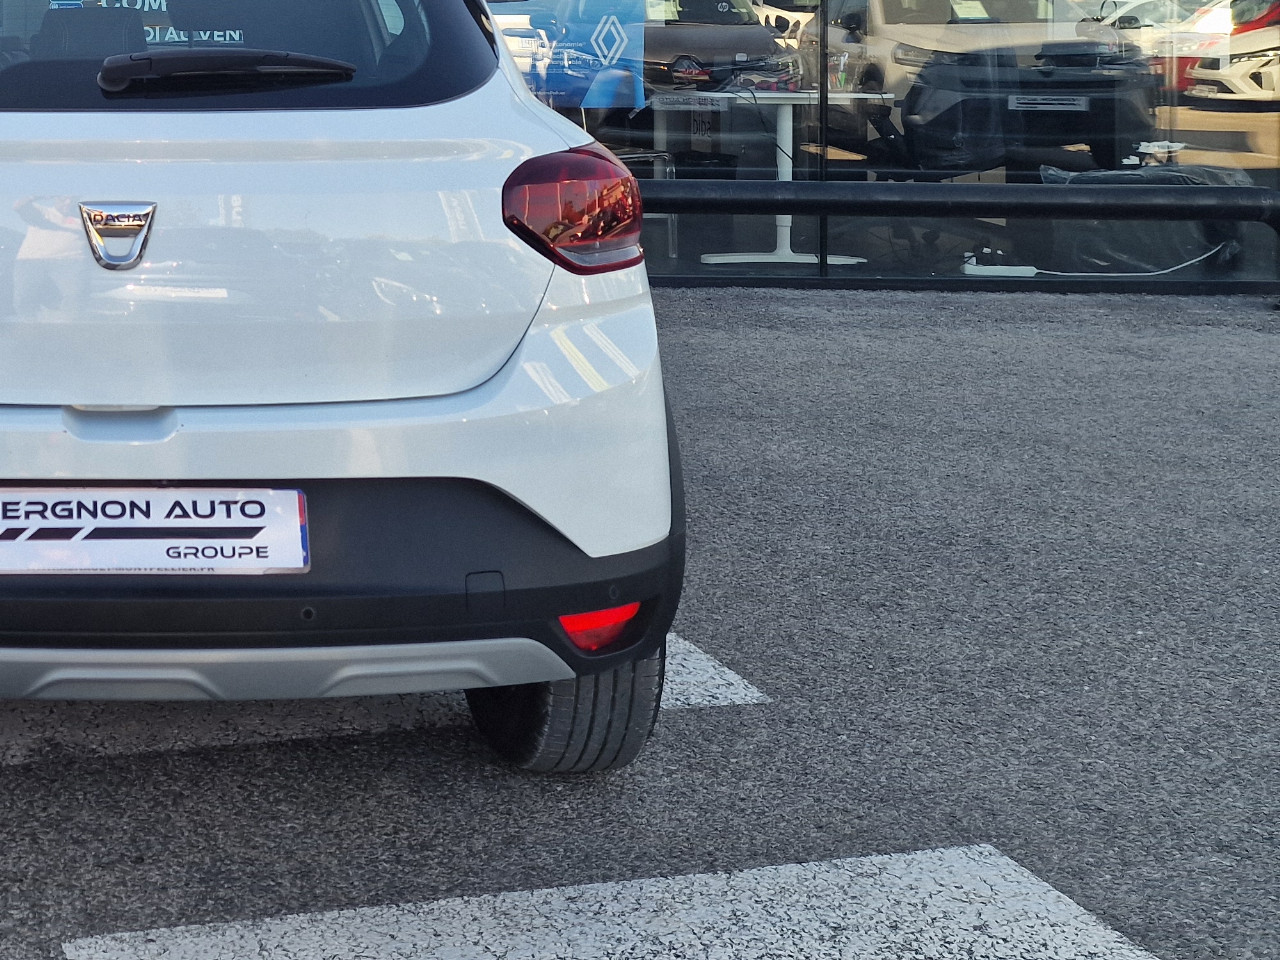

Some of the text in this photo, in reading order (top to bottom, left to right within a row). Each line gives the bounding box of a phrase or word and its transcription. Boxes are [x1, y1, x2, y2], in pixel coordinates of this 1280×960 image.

[93, 214, 143, 223] DACIA
[164, 500, 267, 520] AUTO
[166, 545, 269, 559] GROUPE
